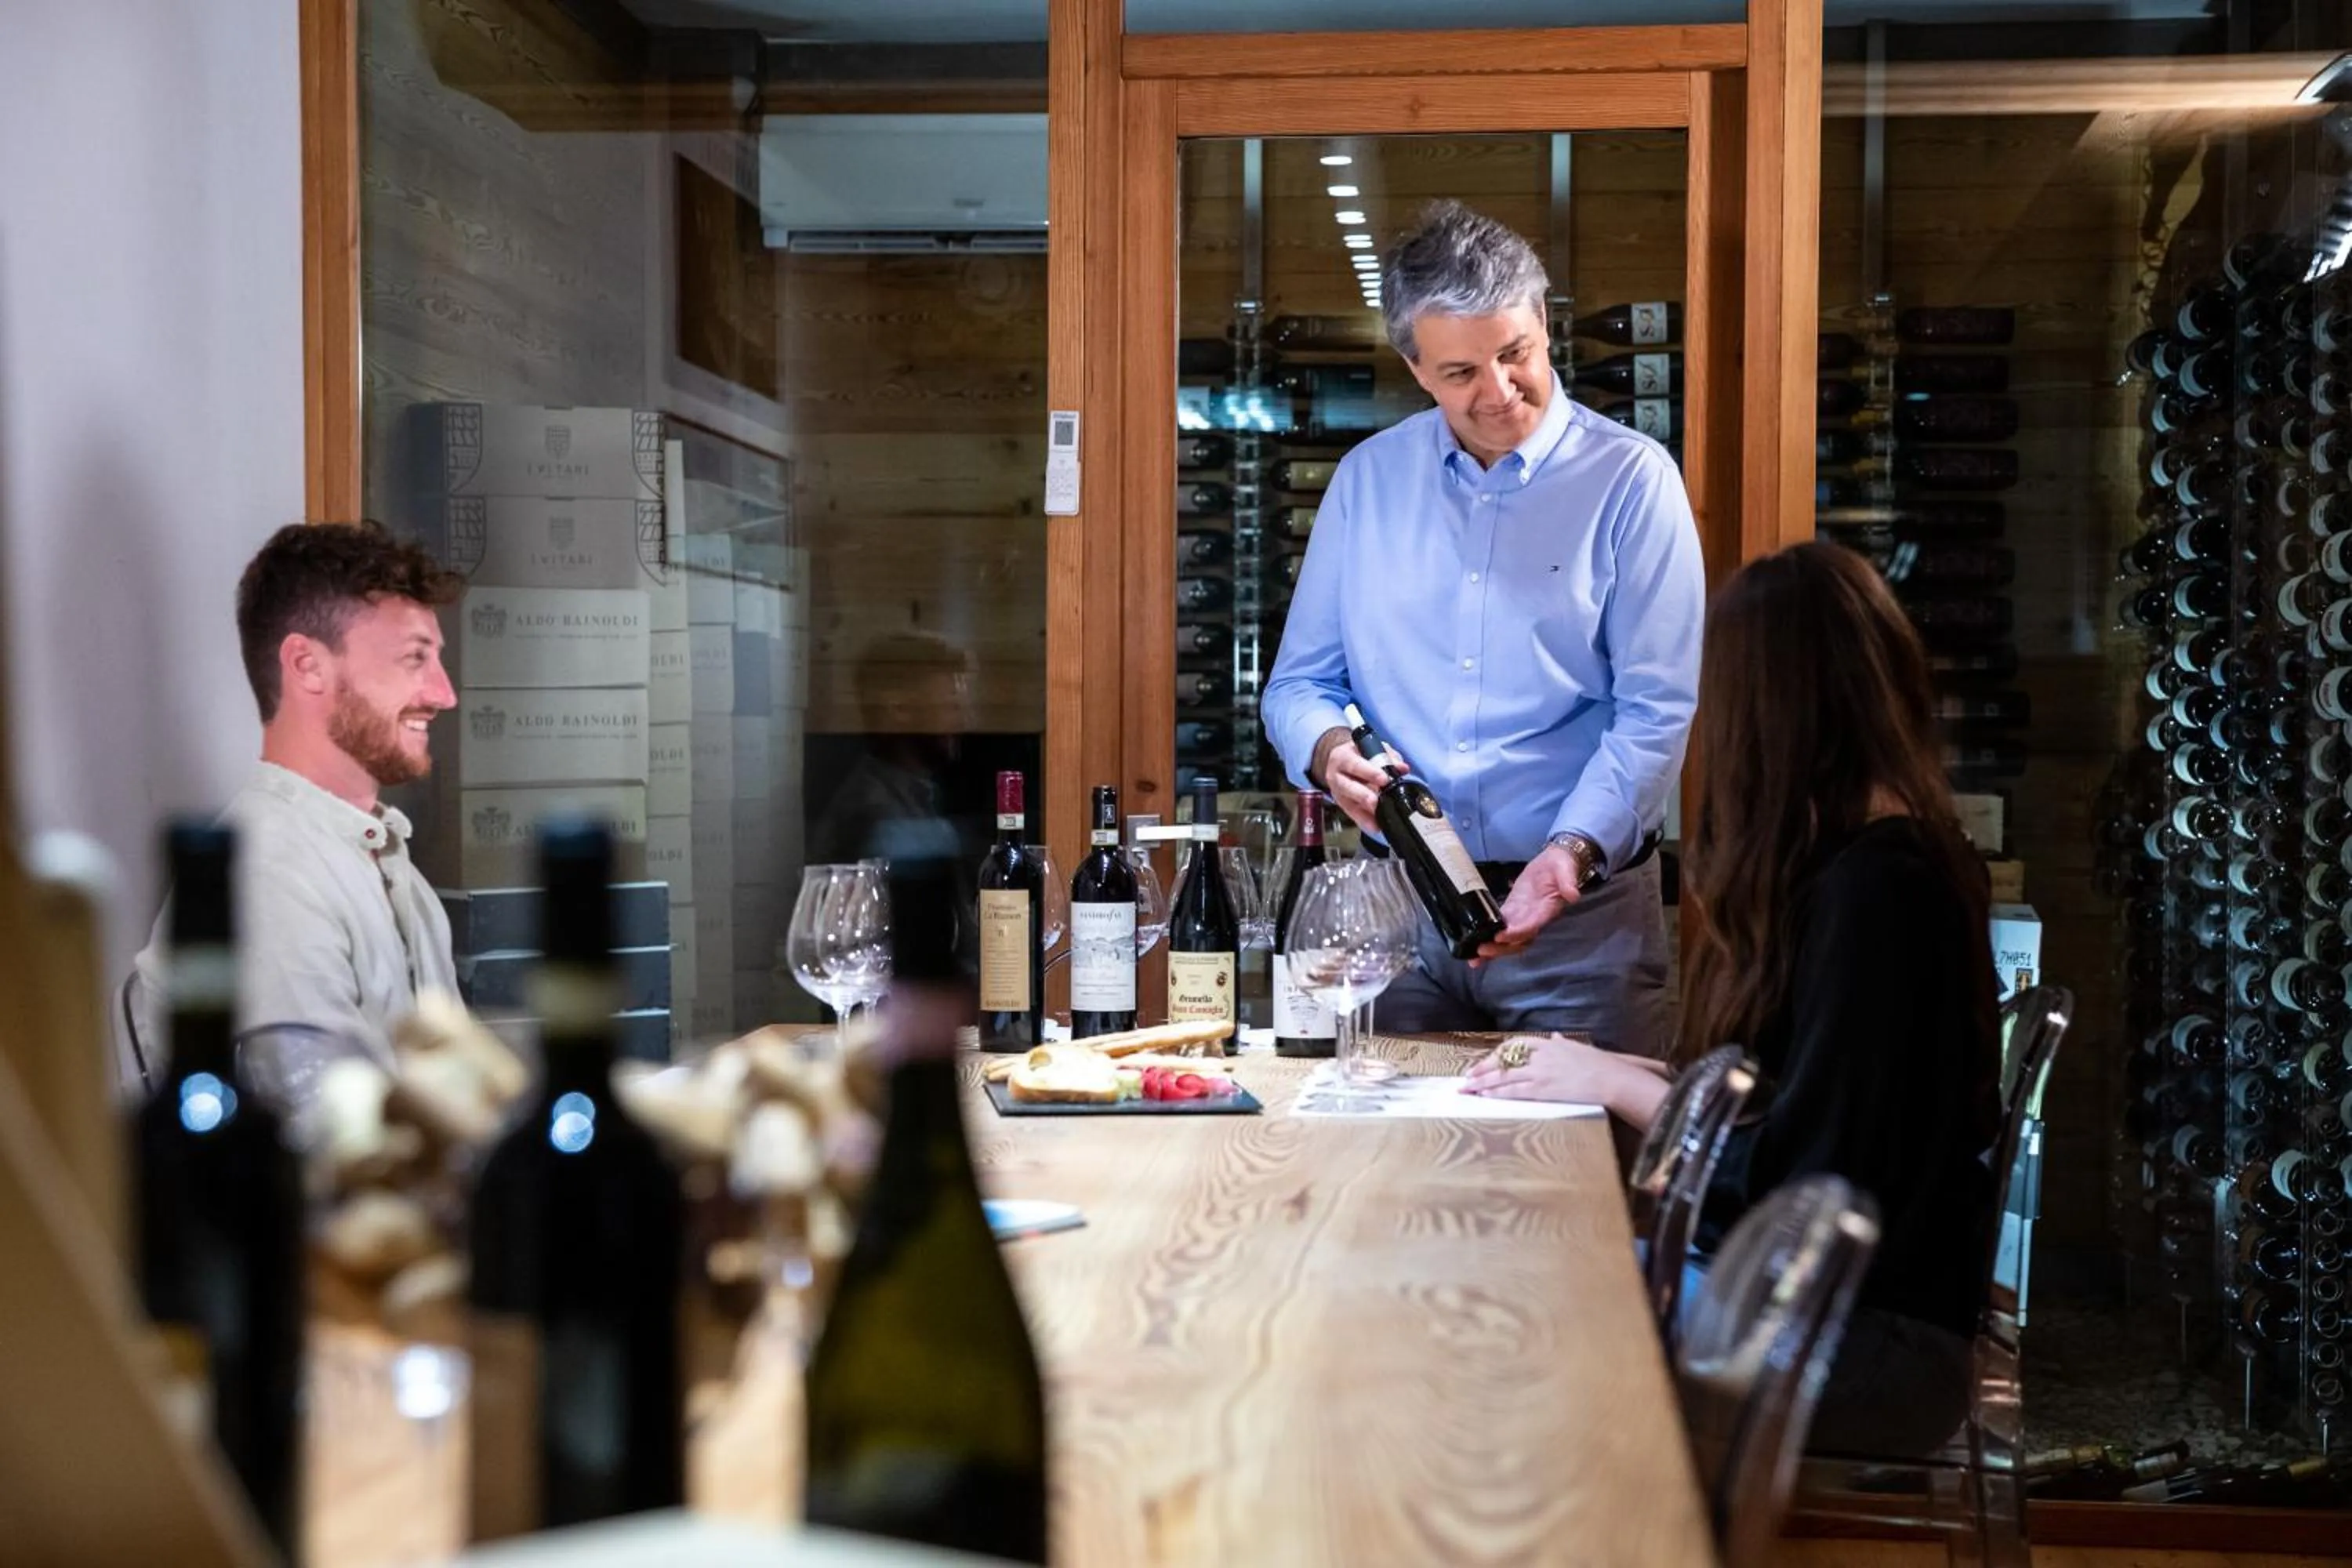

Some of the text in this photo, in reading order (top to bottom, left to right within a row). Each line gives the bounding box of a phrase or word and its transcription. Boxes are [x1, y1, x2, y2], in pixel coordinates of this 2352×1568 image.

[515, 614, 638, 626] ALDO RAINOLDI
[514, 713, 637, 727] ALDO RAINOLDI
